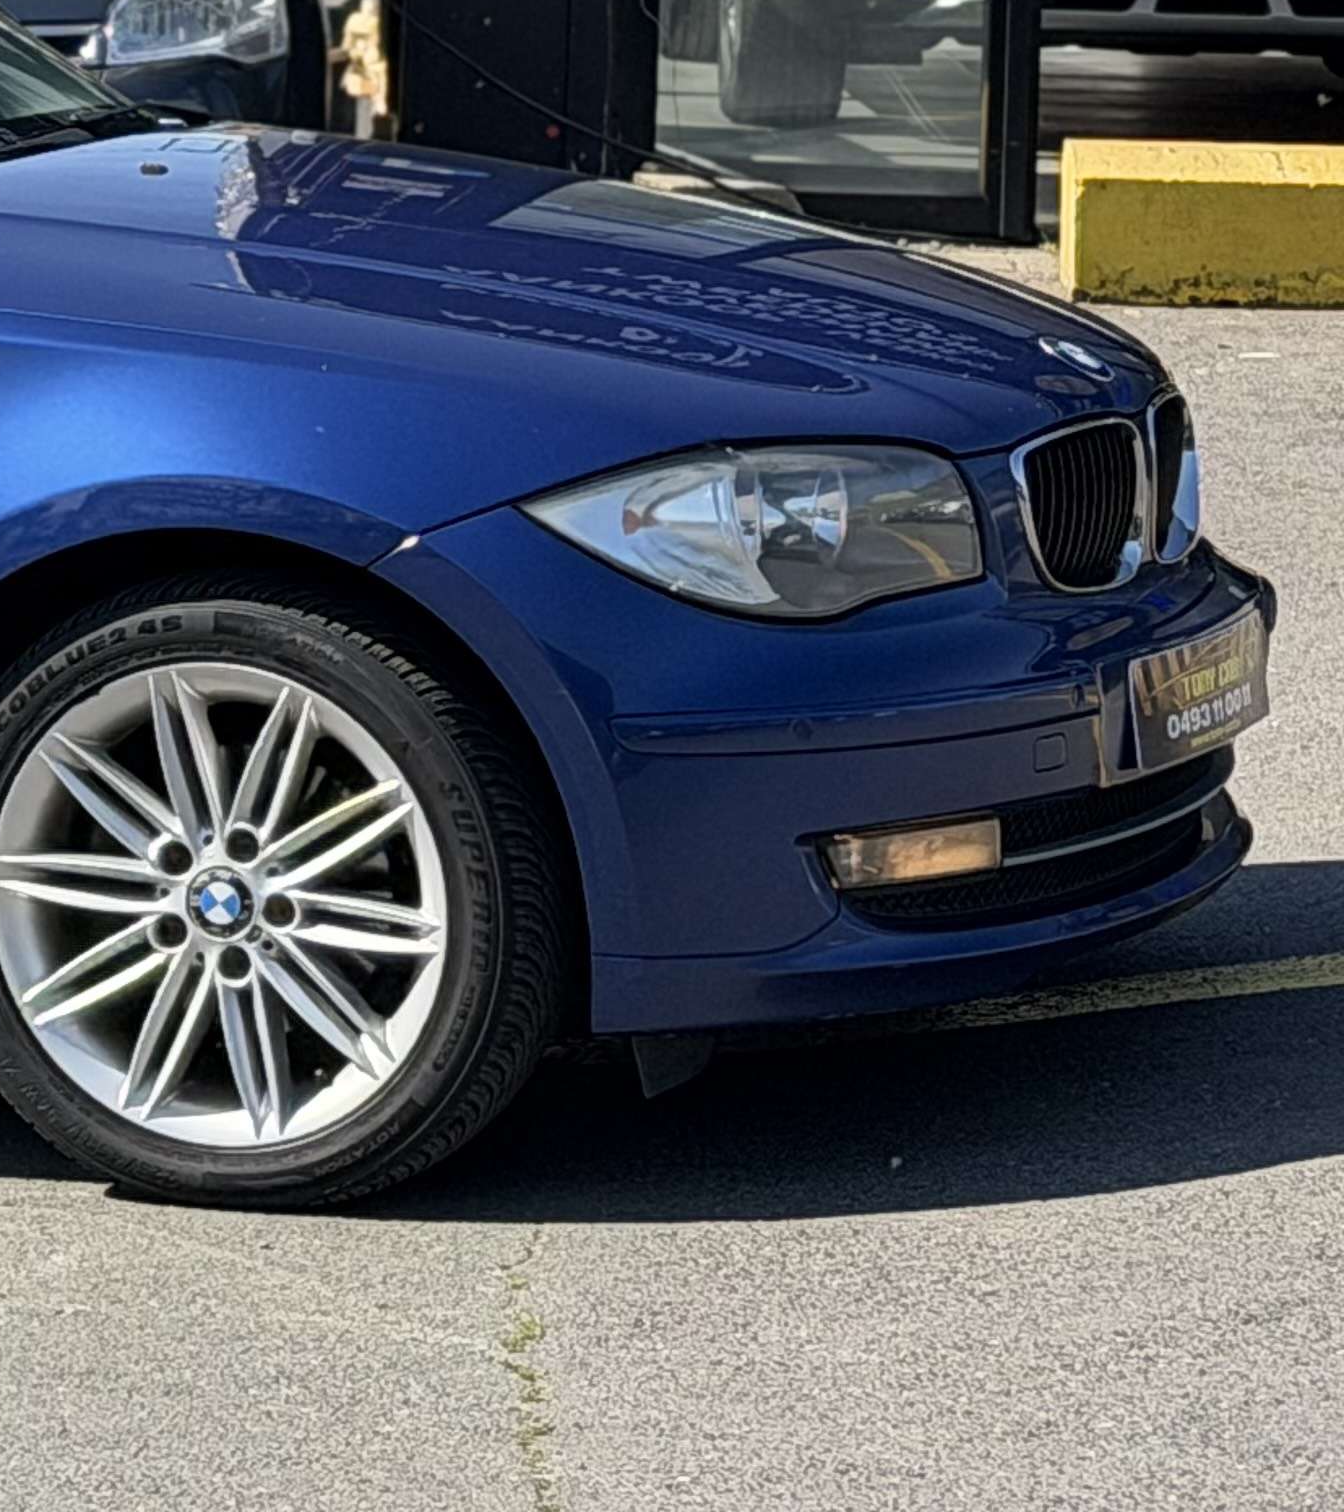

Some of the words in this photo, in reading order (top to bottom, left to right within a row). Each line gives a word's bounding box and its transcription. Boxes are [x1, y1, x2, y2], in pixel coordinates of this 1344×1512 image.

[1167, 701, 1211, 740] 0493
[1212, 696, 1225, 724] 11
[1225, 687, 1242, 716] 00
[1241, 682, 1252, 707] 11
